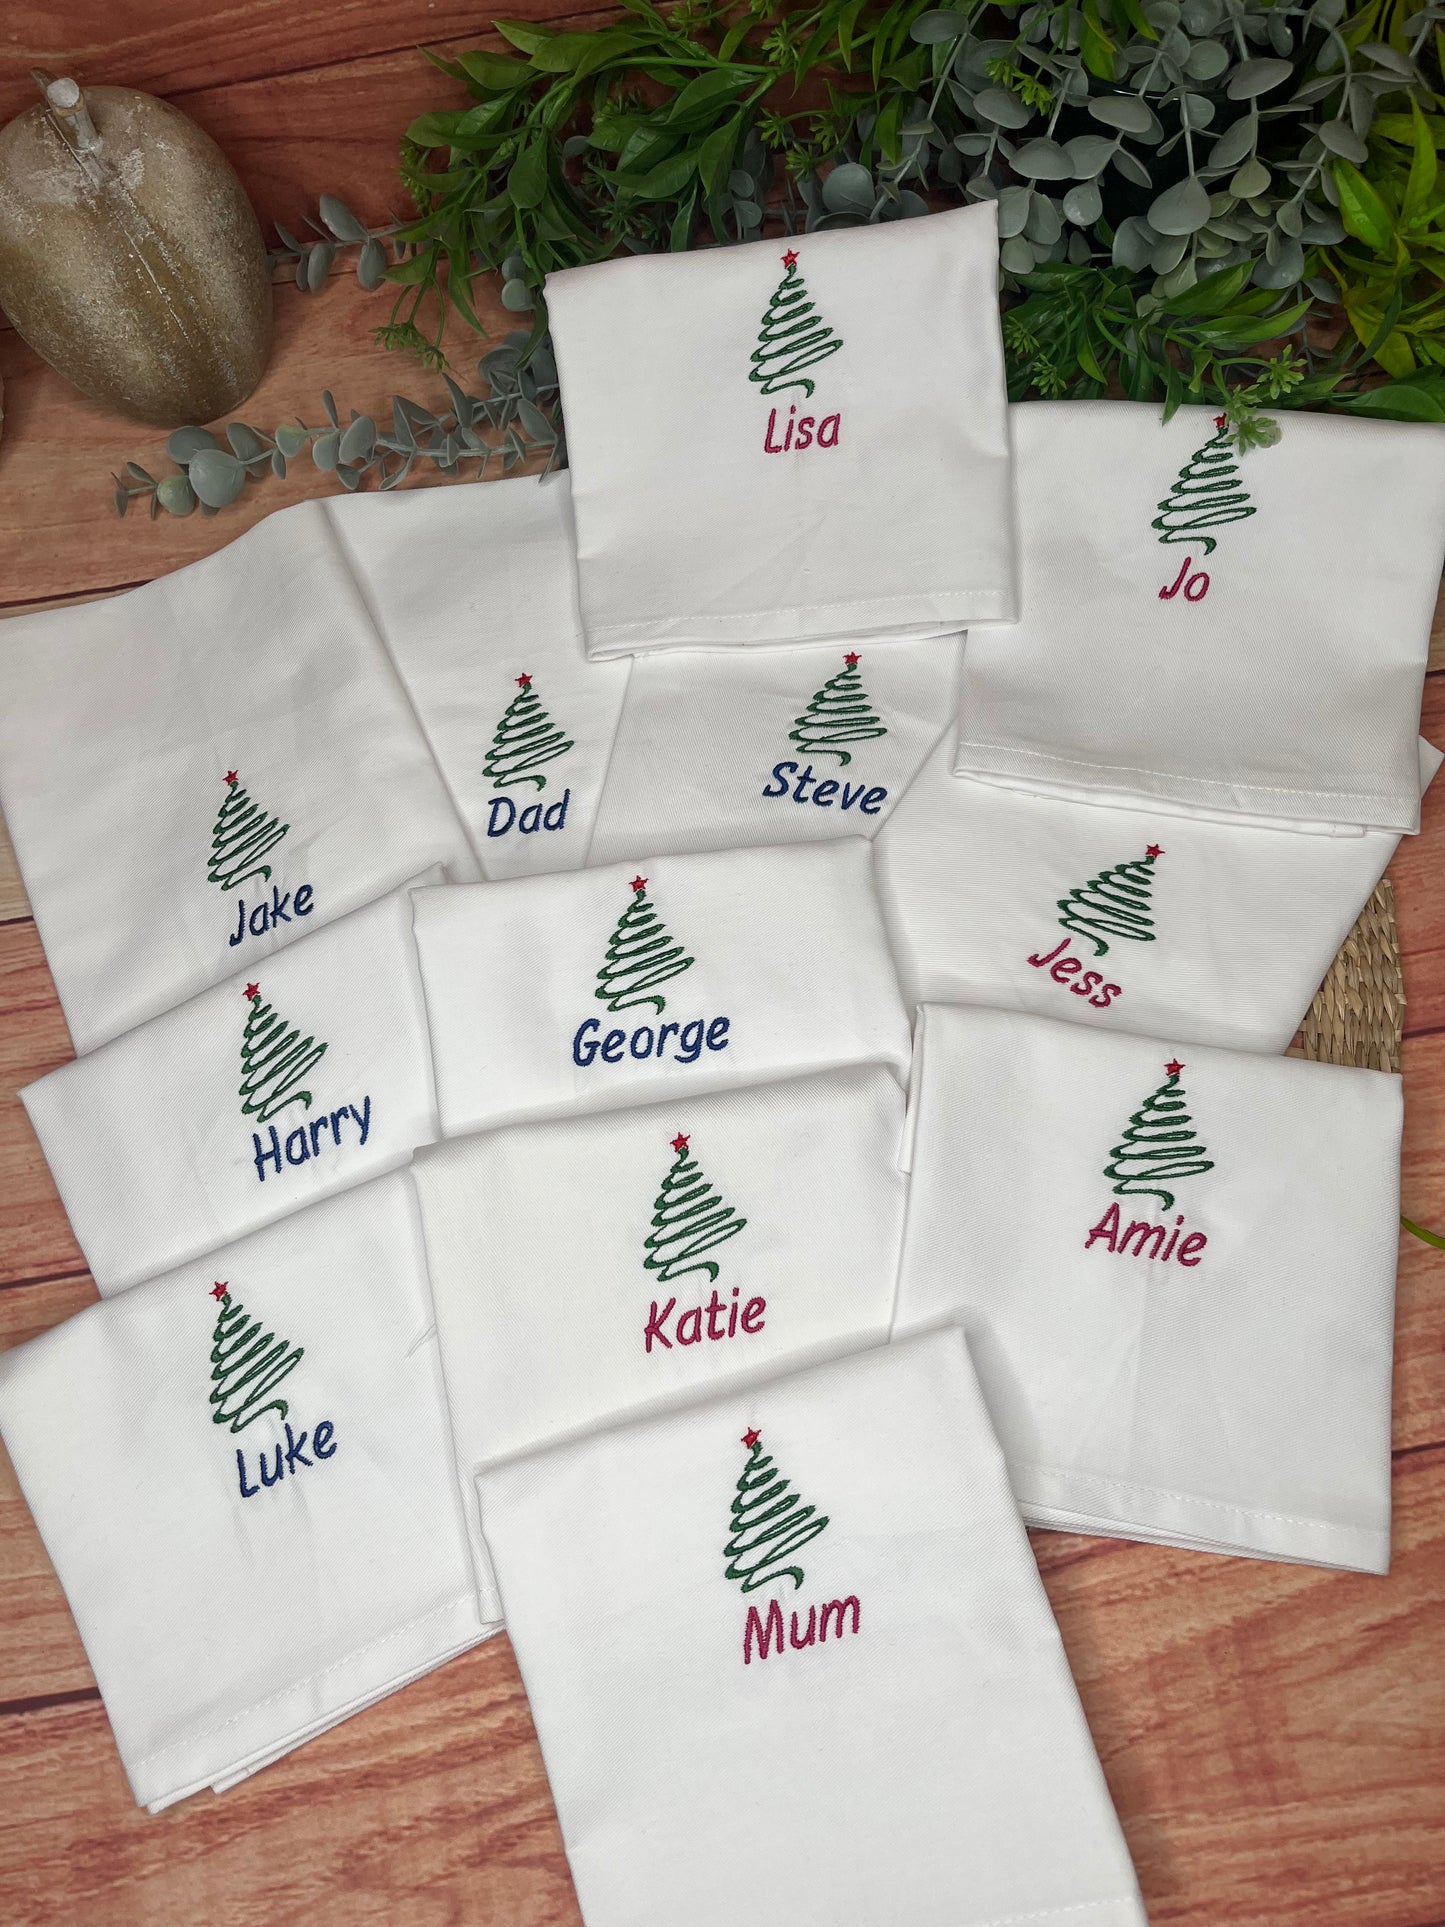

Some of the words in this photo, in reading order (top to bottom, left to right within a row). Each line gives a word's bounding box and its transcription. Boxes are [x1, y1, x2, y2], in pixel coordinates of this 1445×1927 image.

[764, 405, 840, 453] Lisa
[1158, 557, 1210, 602] Jo
[487, 788, 570, 837] Dad
[762, 761, 887, 815] Steve
[229, 884, 314, 947] Jake
[1026, 938, 1122, 1008] Jess
[572, 1016, 730, 1067] George
[252, 1096, 371, 1181] Harry
[1085, 1202, 1207, 1267] Amie
[644, 1287, 766, 1353] Katie
[236, 1420, 337, 1498] Luke
[743, 1595, 860, 1665] Mum
